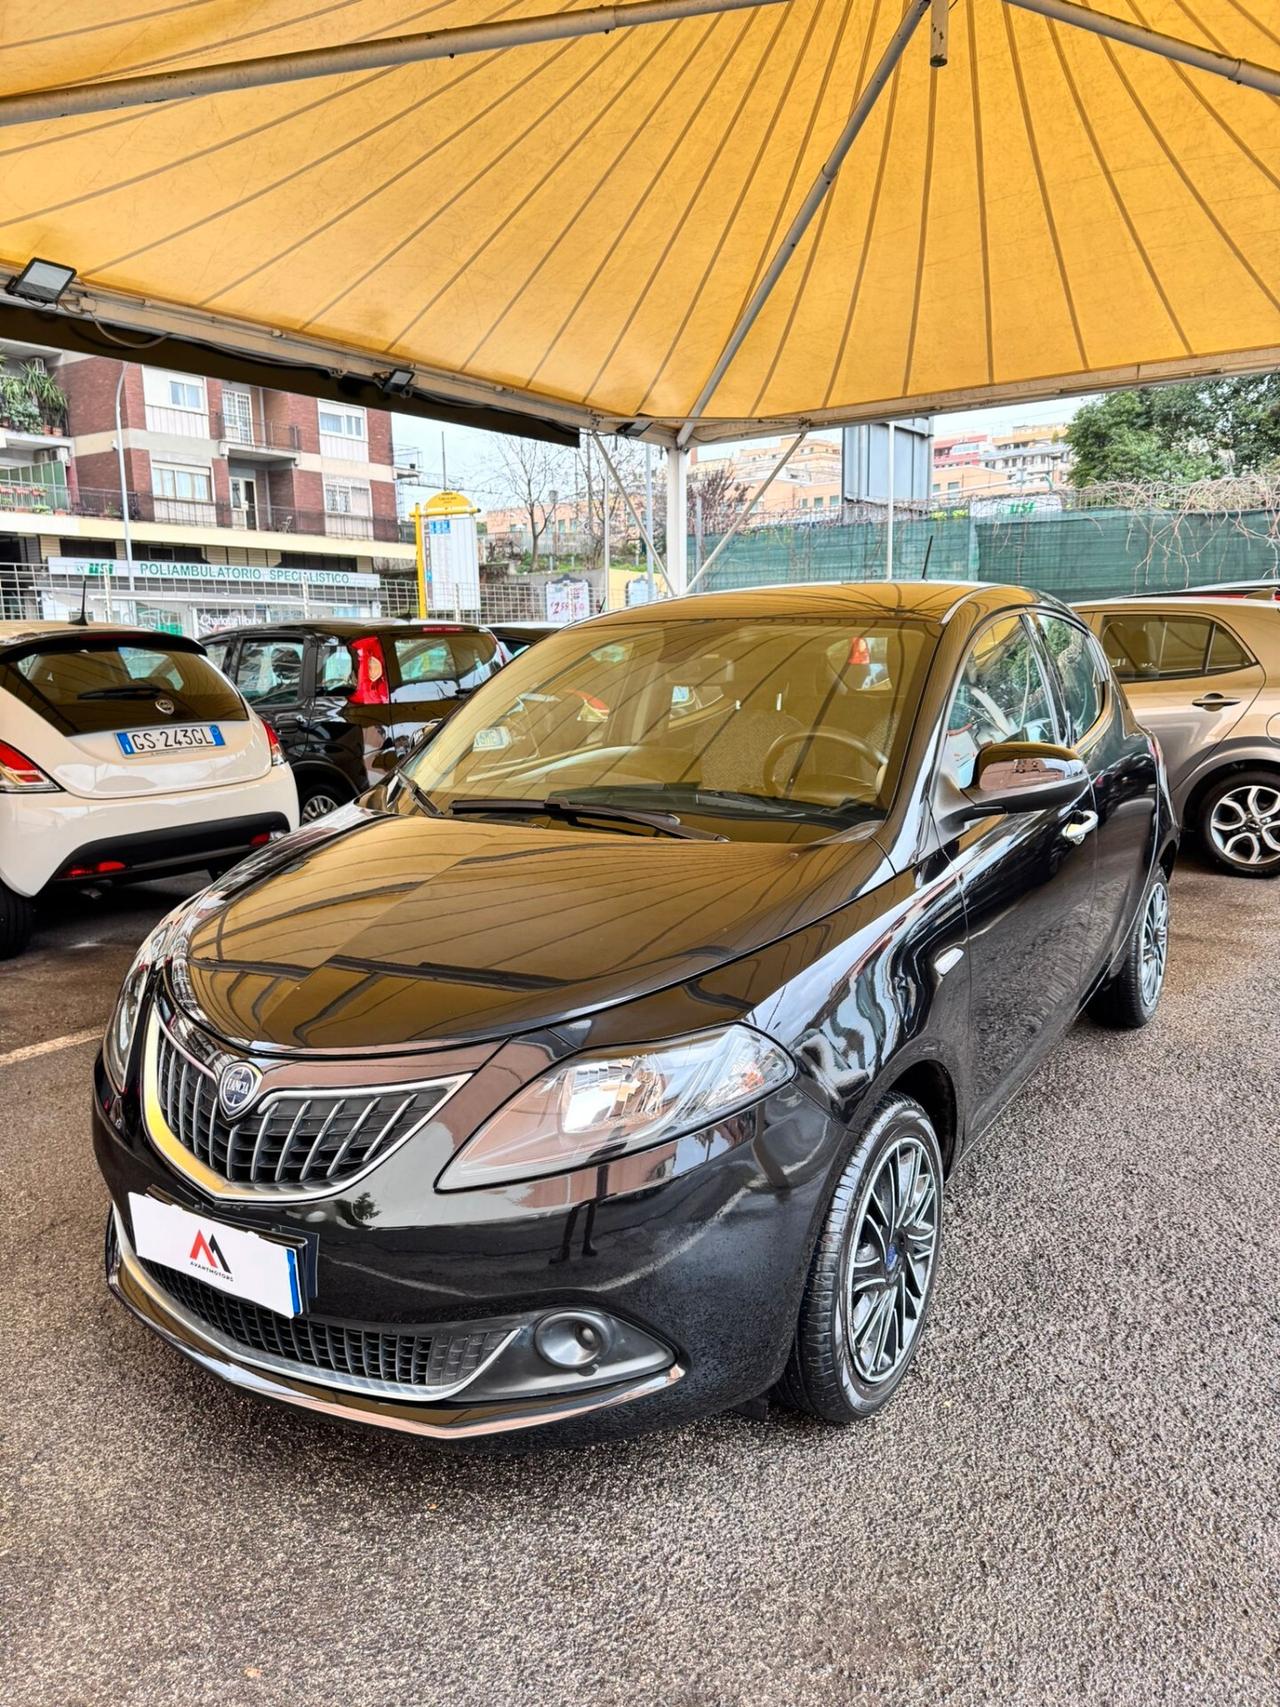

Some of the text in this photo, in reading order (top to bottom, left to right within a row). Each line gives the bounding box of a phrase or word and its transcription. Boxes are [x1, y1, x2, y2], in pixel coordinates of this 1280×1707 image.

[140, 563, 262, 580] POLIAMBULATORIO
[131, 728, 213, 750] GS 243GL
[226, 1078, 249, 1096] LANCIA
